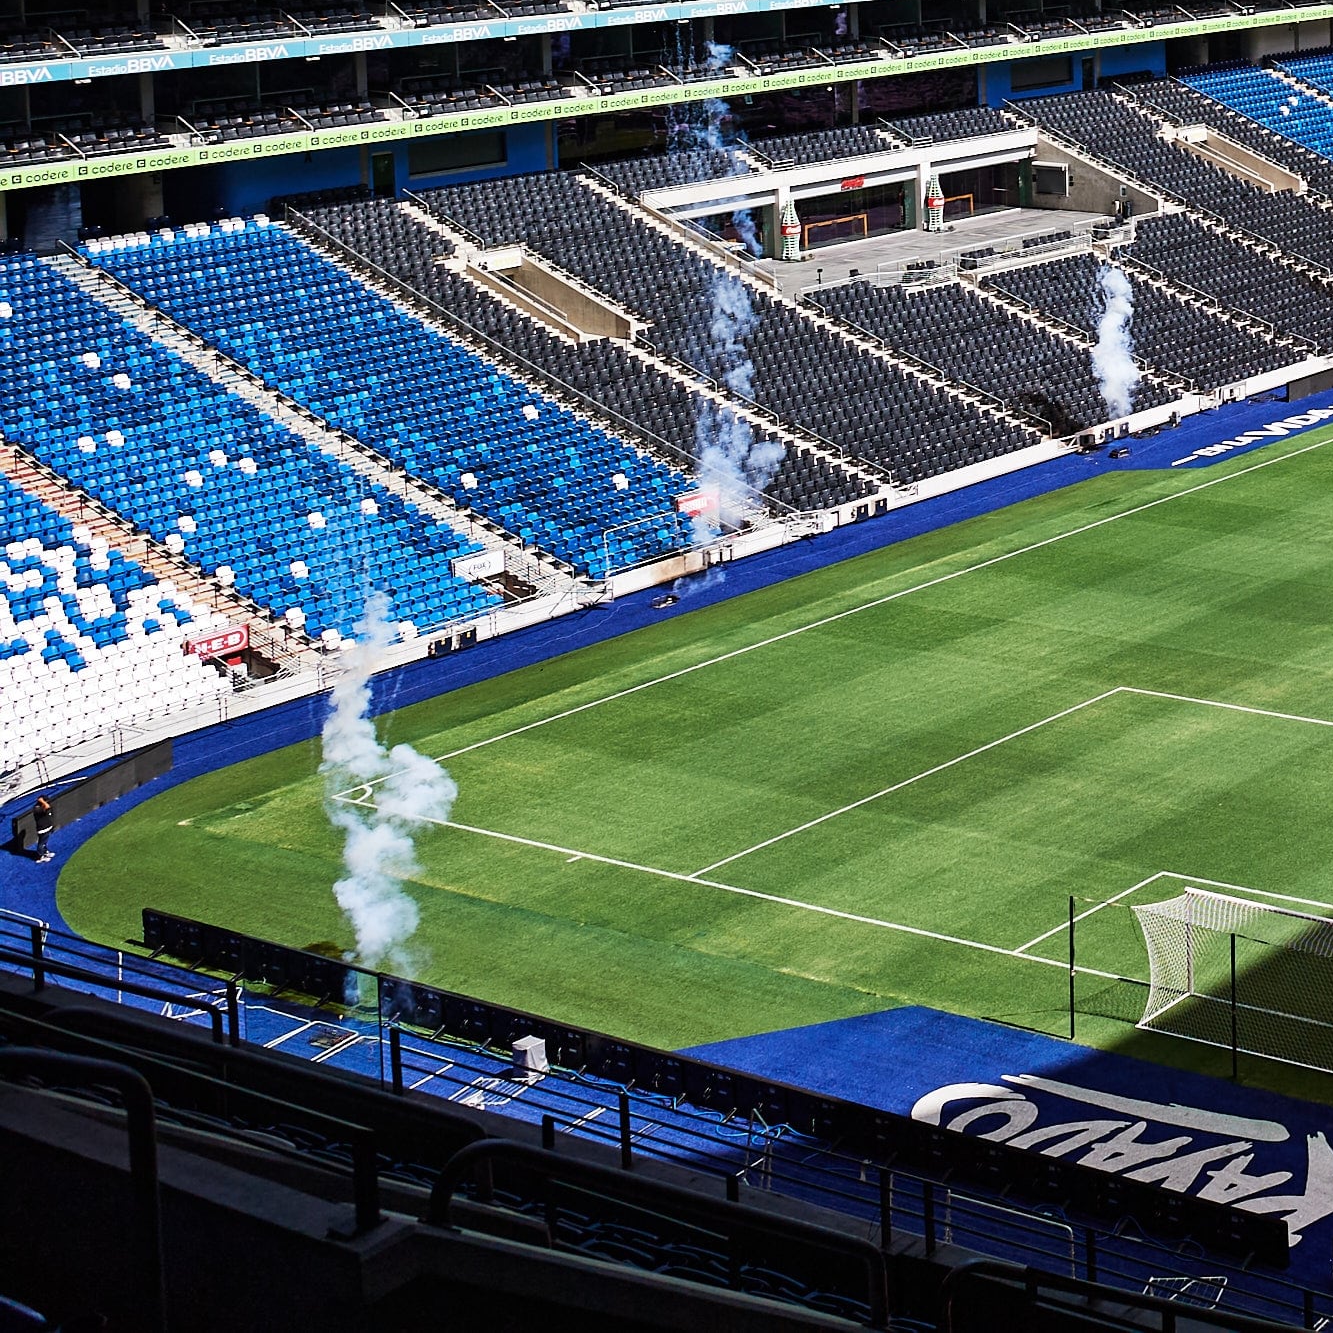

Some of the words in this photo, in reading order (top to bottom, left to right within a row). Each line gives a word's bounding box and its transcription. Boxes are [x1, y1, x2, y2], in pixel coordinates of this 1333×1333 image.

[2, 67, 52, 86] BBVA
[89, 62, 126, 74] Estadio
[128, 54, 174, 71] BBVA
[209, 51, 244, 64] Estadio
[245, 44, 288, 60] BBVA
[318, 41, 352, 53] Estadio
[352, 35, 393, 50] BBVA
[422, 32, 452, 43] Estadio
[453, 26, 491, 40] BBVA
[518, 23, 546, 34] Estadio
[547, 17, 582, 31] BBVA
[608, 15, 634, 26] Estadio
[635, 9, 668, 23] BBVA
[716, 1, 748, 14] BBVA
[26, 167, 68, 182] codere
[92, 159, 132, 173] codere
[149, 152, 189, 166] codere
[212, 145, 249, 158] codere
[265, 138, 302, 152] codere
[322, 130, 357, 144] codere
[372, 124, 406, 137] codere
[425, 117, 458, 131] codere
[471, 112, 502, 125] codere
[521, 106, 550, 119] codere
[564, 101, 592, 114] codere
[610, 96, 638, 109] codere
[650, 89, 678, 101] codere
[691, 84, 720, 96] codere
[730, 80, 756, 92] codere
[771, 75, 796, 87] codere
[807, 71, 831, 83] codere
[844, 67, 868, 78] codere
[878, 64, 901, 75] codere
[914, 60, 936, 71] codere
